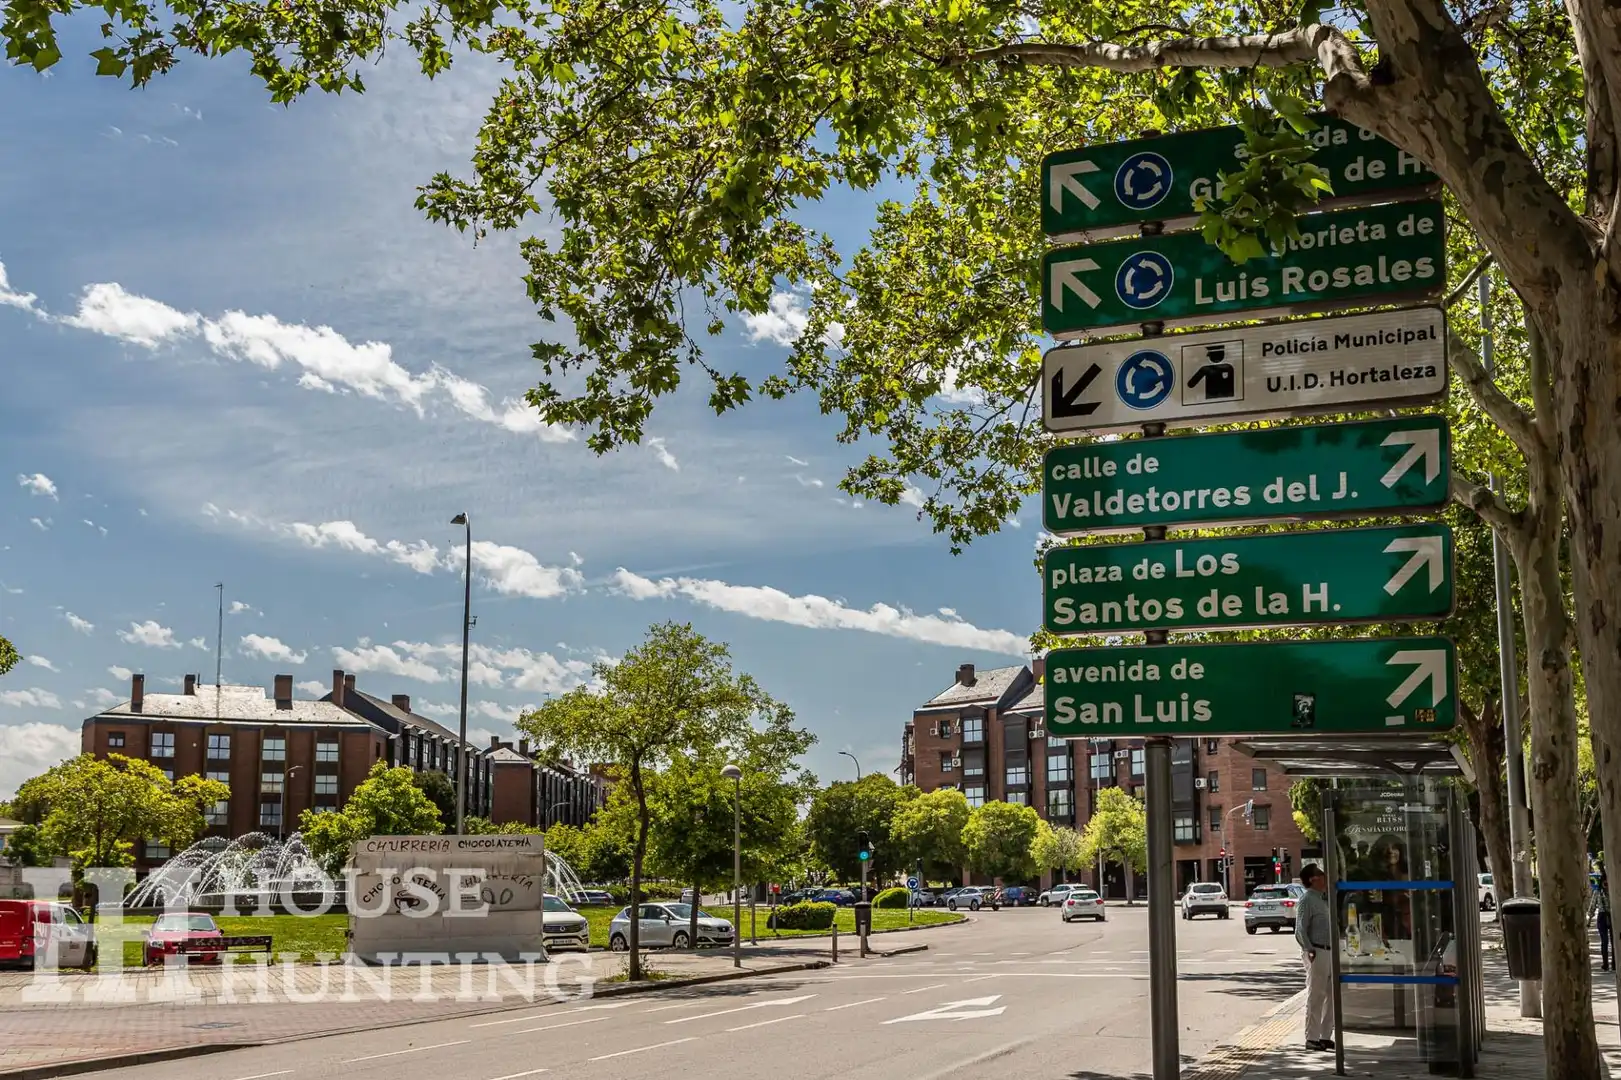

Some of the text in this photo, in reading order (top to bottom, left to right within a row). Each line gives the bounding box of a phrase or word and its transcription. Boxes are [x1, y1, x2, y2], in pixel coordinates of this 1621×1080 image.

[1344, 155, 1386, 182] de
[1396, 213, 1434, 237] de
[1195, 255, 1435, 305] Luis Rosales
[1261, 325, 1437, 358] Policía Municipal
[1266, 364, 1437, 393] U.I.D. Hortaleza
[1051, 453, 1159, 481] calle de
[1052, 471, 1358, 519] Valdetorres del J.
[1052, 549, 1240, 589] plaza de Los
[1053, 582, 1342, 625] Santos de la H.
[1053, 658, 1205, 684] avenida de
[1053, 692, 1213, 725] San Luis
